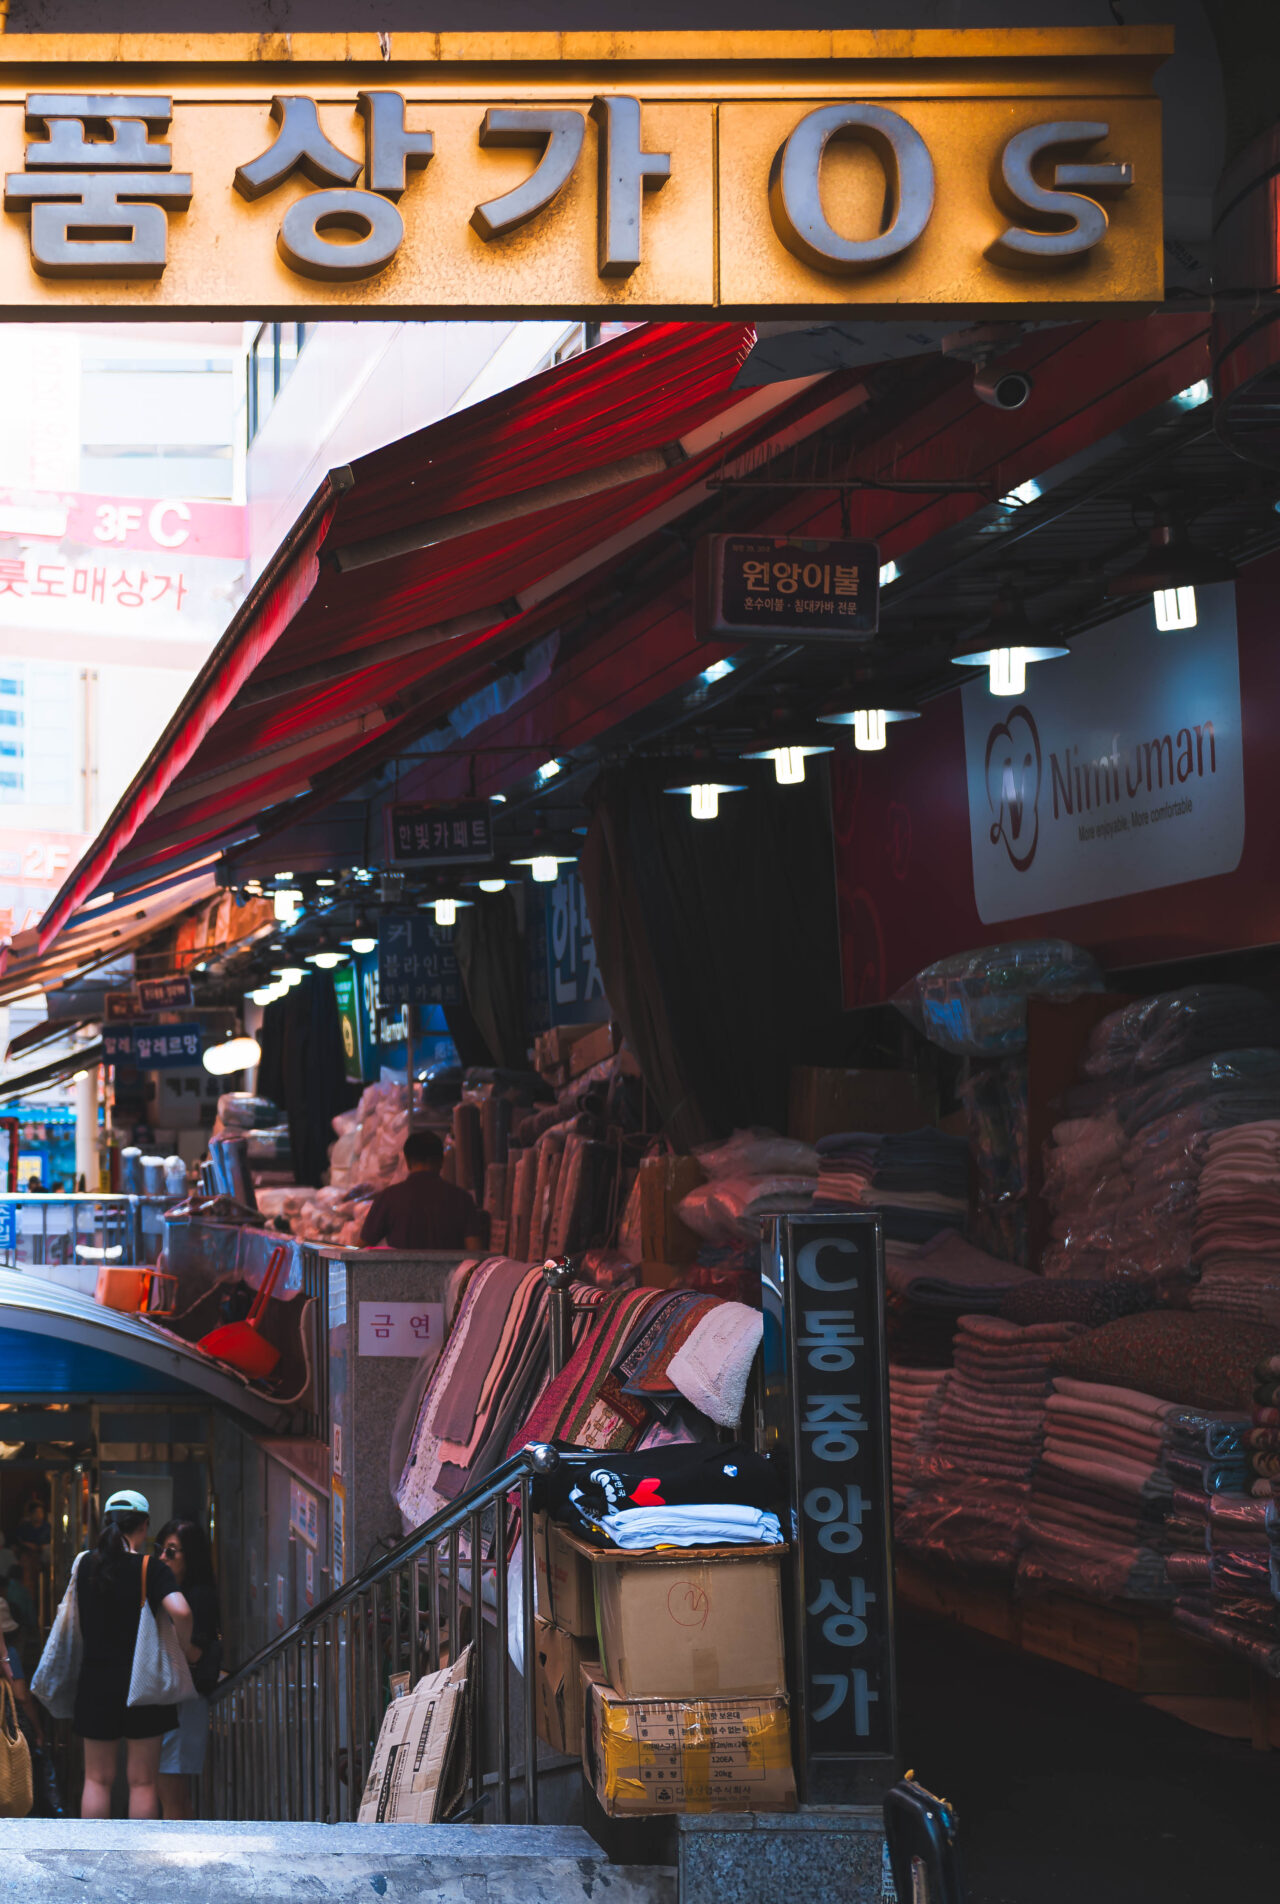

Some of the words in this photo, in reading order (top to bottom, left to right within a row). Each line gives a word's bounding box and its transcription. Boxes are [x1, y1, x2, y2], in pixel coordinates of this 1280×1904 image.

[93, 503, 143, 541] 3F
[148, 500, 192, 548] C
[742, 560, 860, 596] 원앙이불
[1078, 824, 1095, 842] More
[1131, 810, 1148, 828] More
[137, 1034, 198, 1059] 알레르망
[712, 1755, 734, 1763] 120EA
[714, 1770, 733, 1779] 20kg
